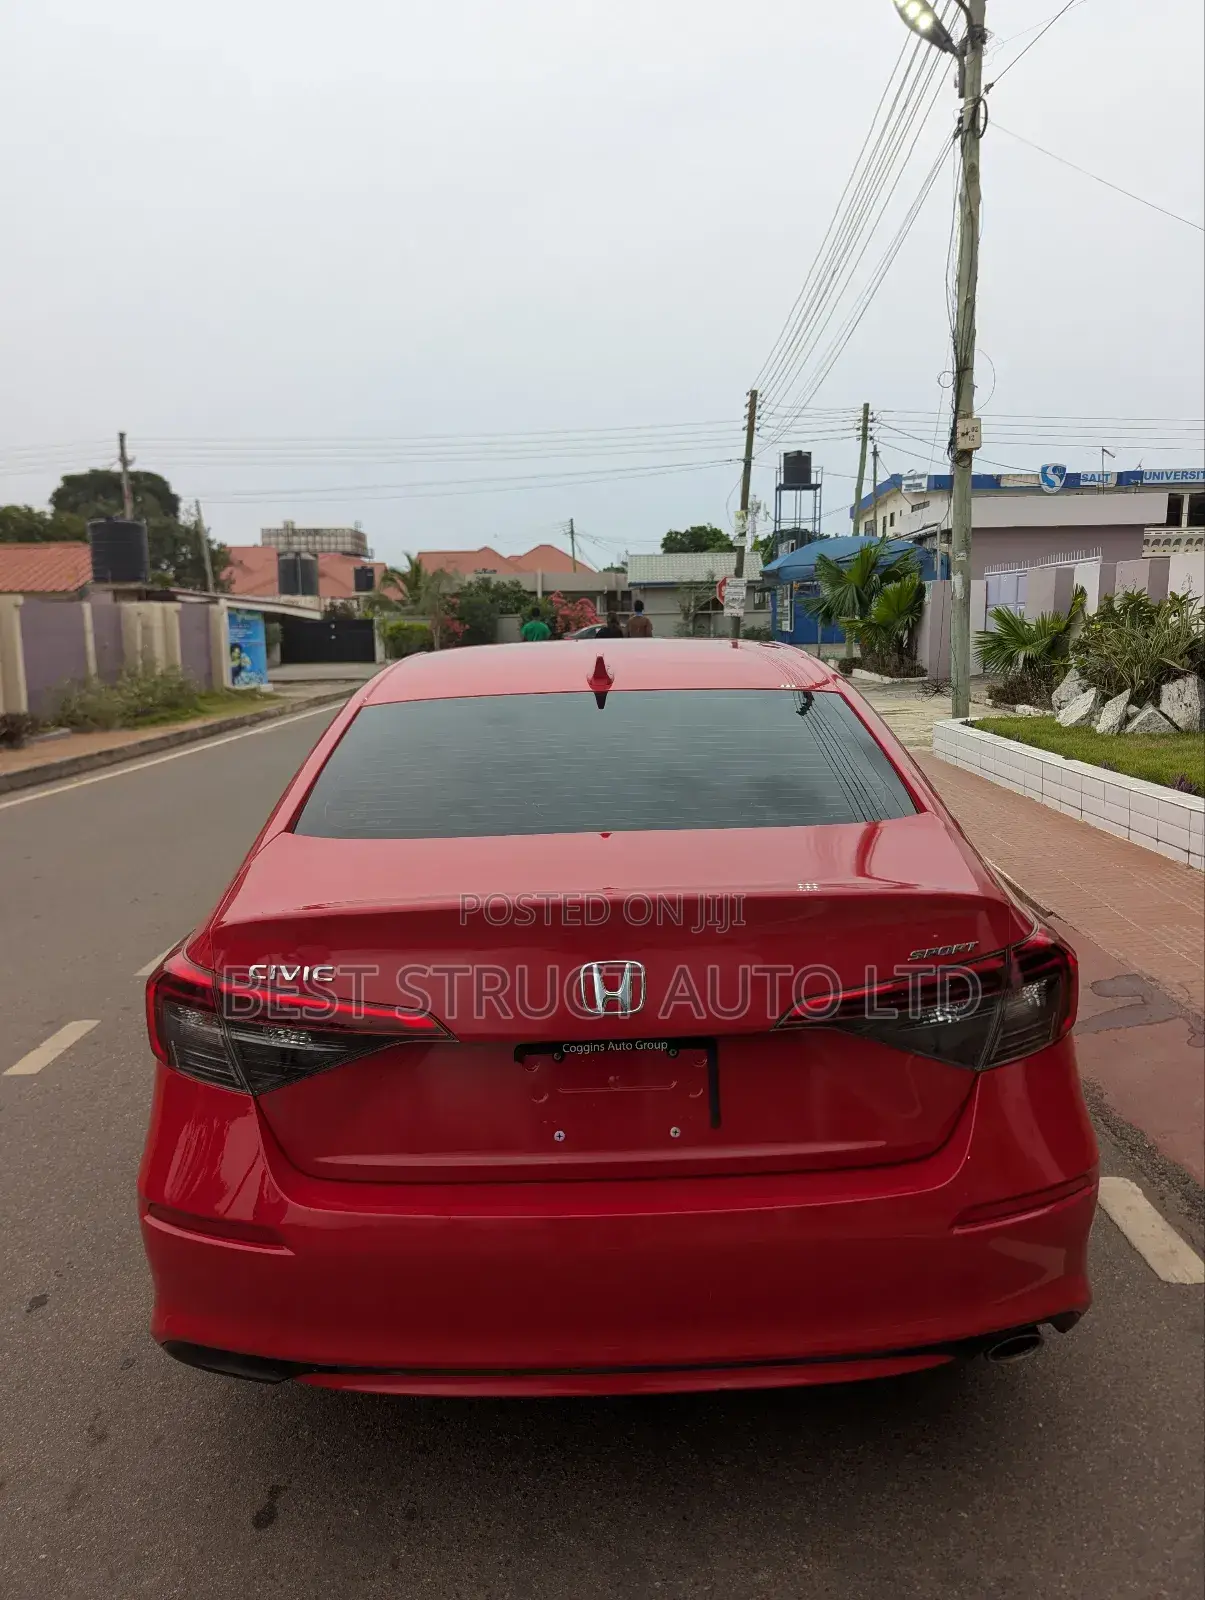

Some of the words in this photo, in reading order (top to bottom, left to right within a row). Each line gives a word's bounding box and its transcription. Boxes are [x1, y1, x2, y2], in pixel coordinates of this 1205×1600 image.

[1081, 473, 1111, 482] SALT
[907, 941, 979, 961] SPORT
[249, 964, 335, 982] CIVIC
[562, 1043, 605, 1055] Coggins
[608, 1042, 633, 1051] Auto
[635, 1040, 668, 1051] Group
